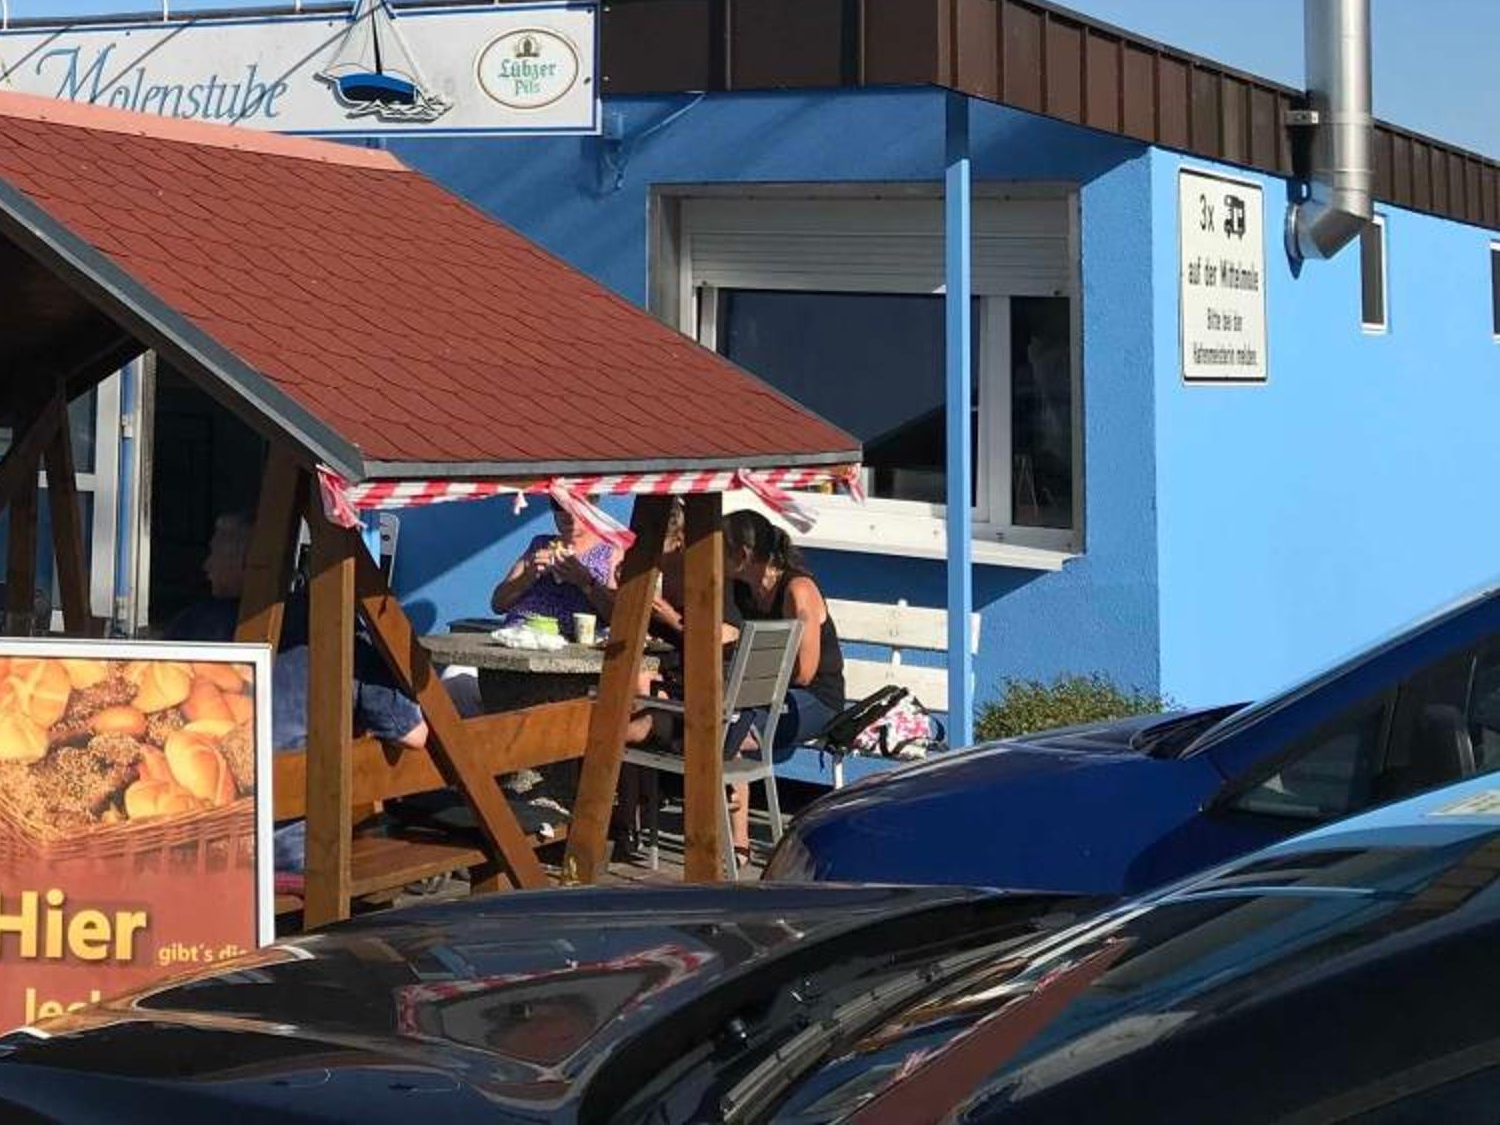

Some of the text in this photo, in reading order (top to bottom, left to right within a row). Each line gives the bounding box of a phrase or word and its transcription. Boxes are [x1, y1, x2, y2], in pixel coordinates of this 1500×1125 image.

[36, 42, 289, 121] Molenstube
[497, 58, 557, 80] Lübzer
[515, 79, 541, 97] Pils
[1199, 193, 1215, 233] 3x
